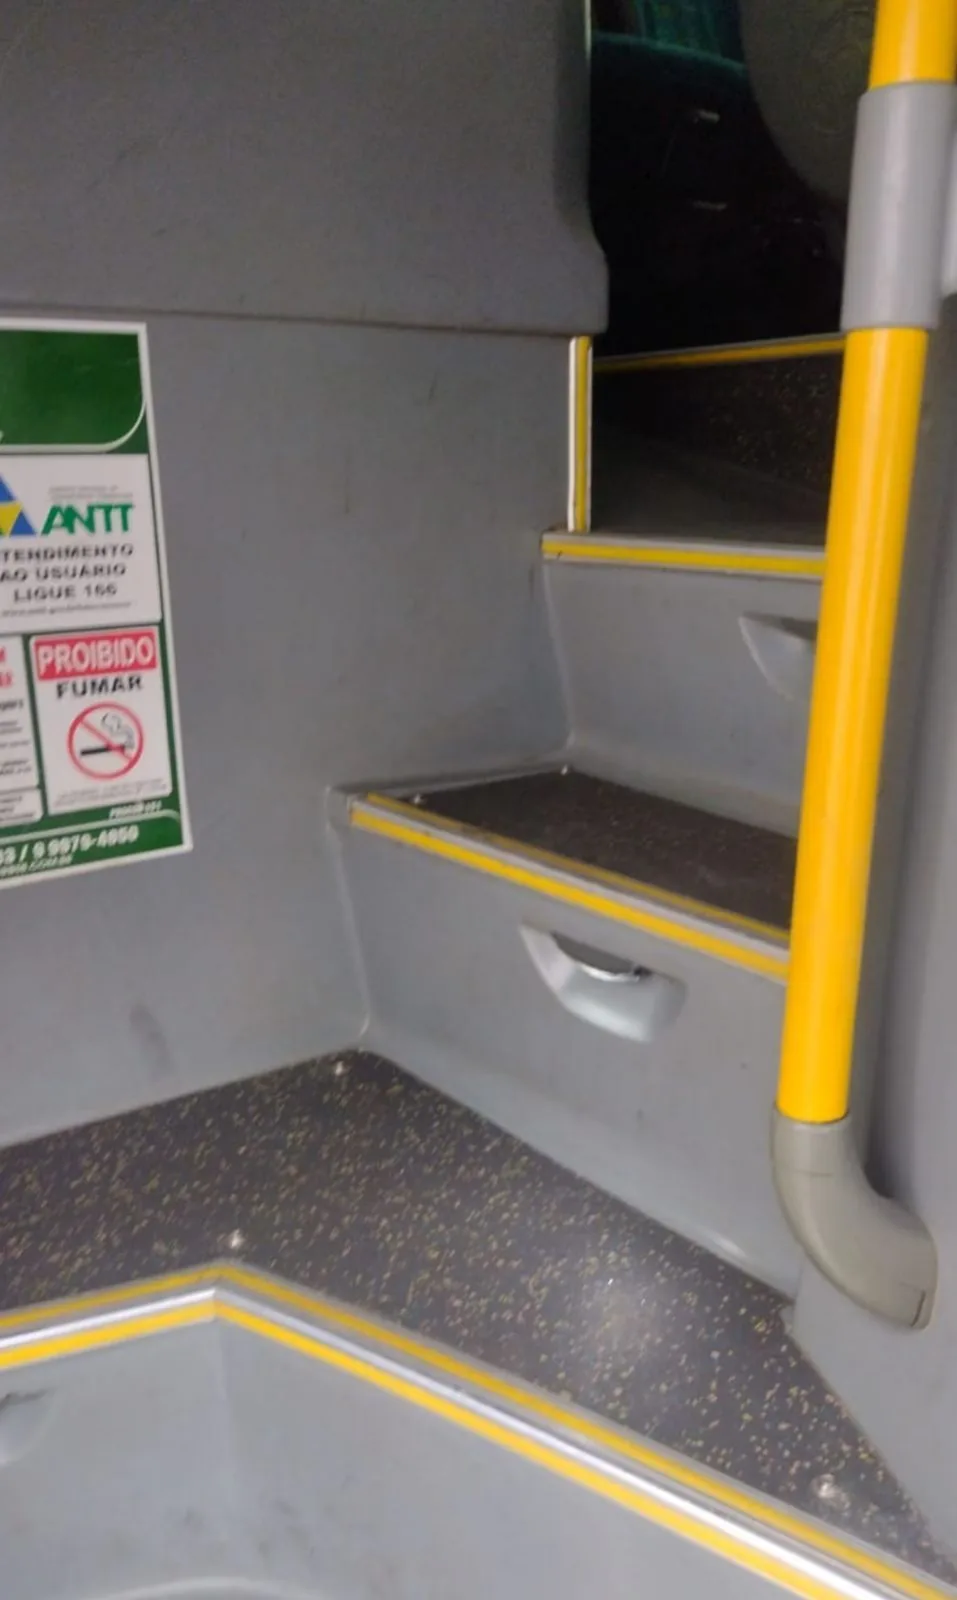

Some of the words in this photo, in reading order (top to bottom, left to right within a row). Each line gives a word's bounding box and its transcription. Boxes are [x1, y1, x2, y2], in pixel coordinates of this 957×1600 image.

[41, 503, 134, 536] ANTT
[0, 567, 28, 583] AO
[14, 585, 76, 603] LIGUE
[84, 582, 117, 598] 166
[38, 636, 155, 675] PROIBIDO
[56, 675, 143, 699] FUMAR
